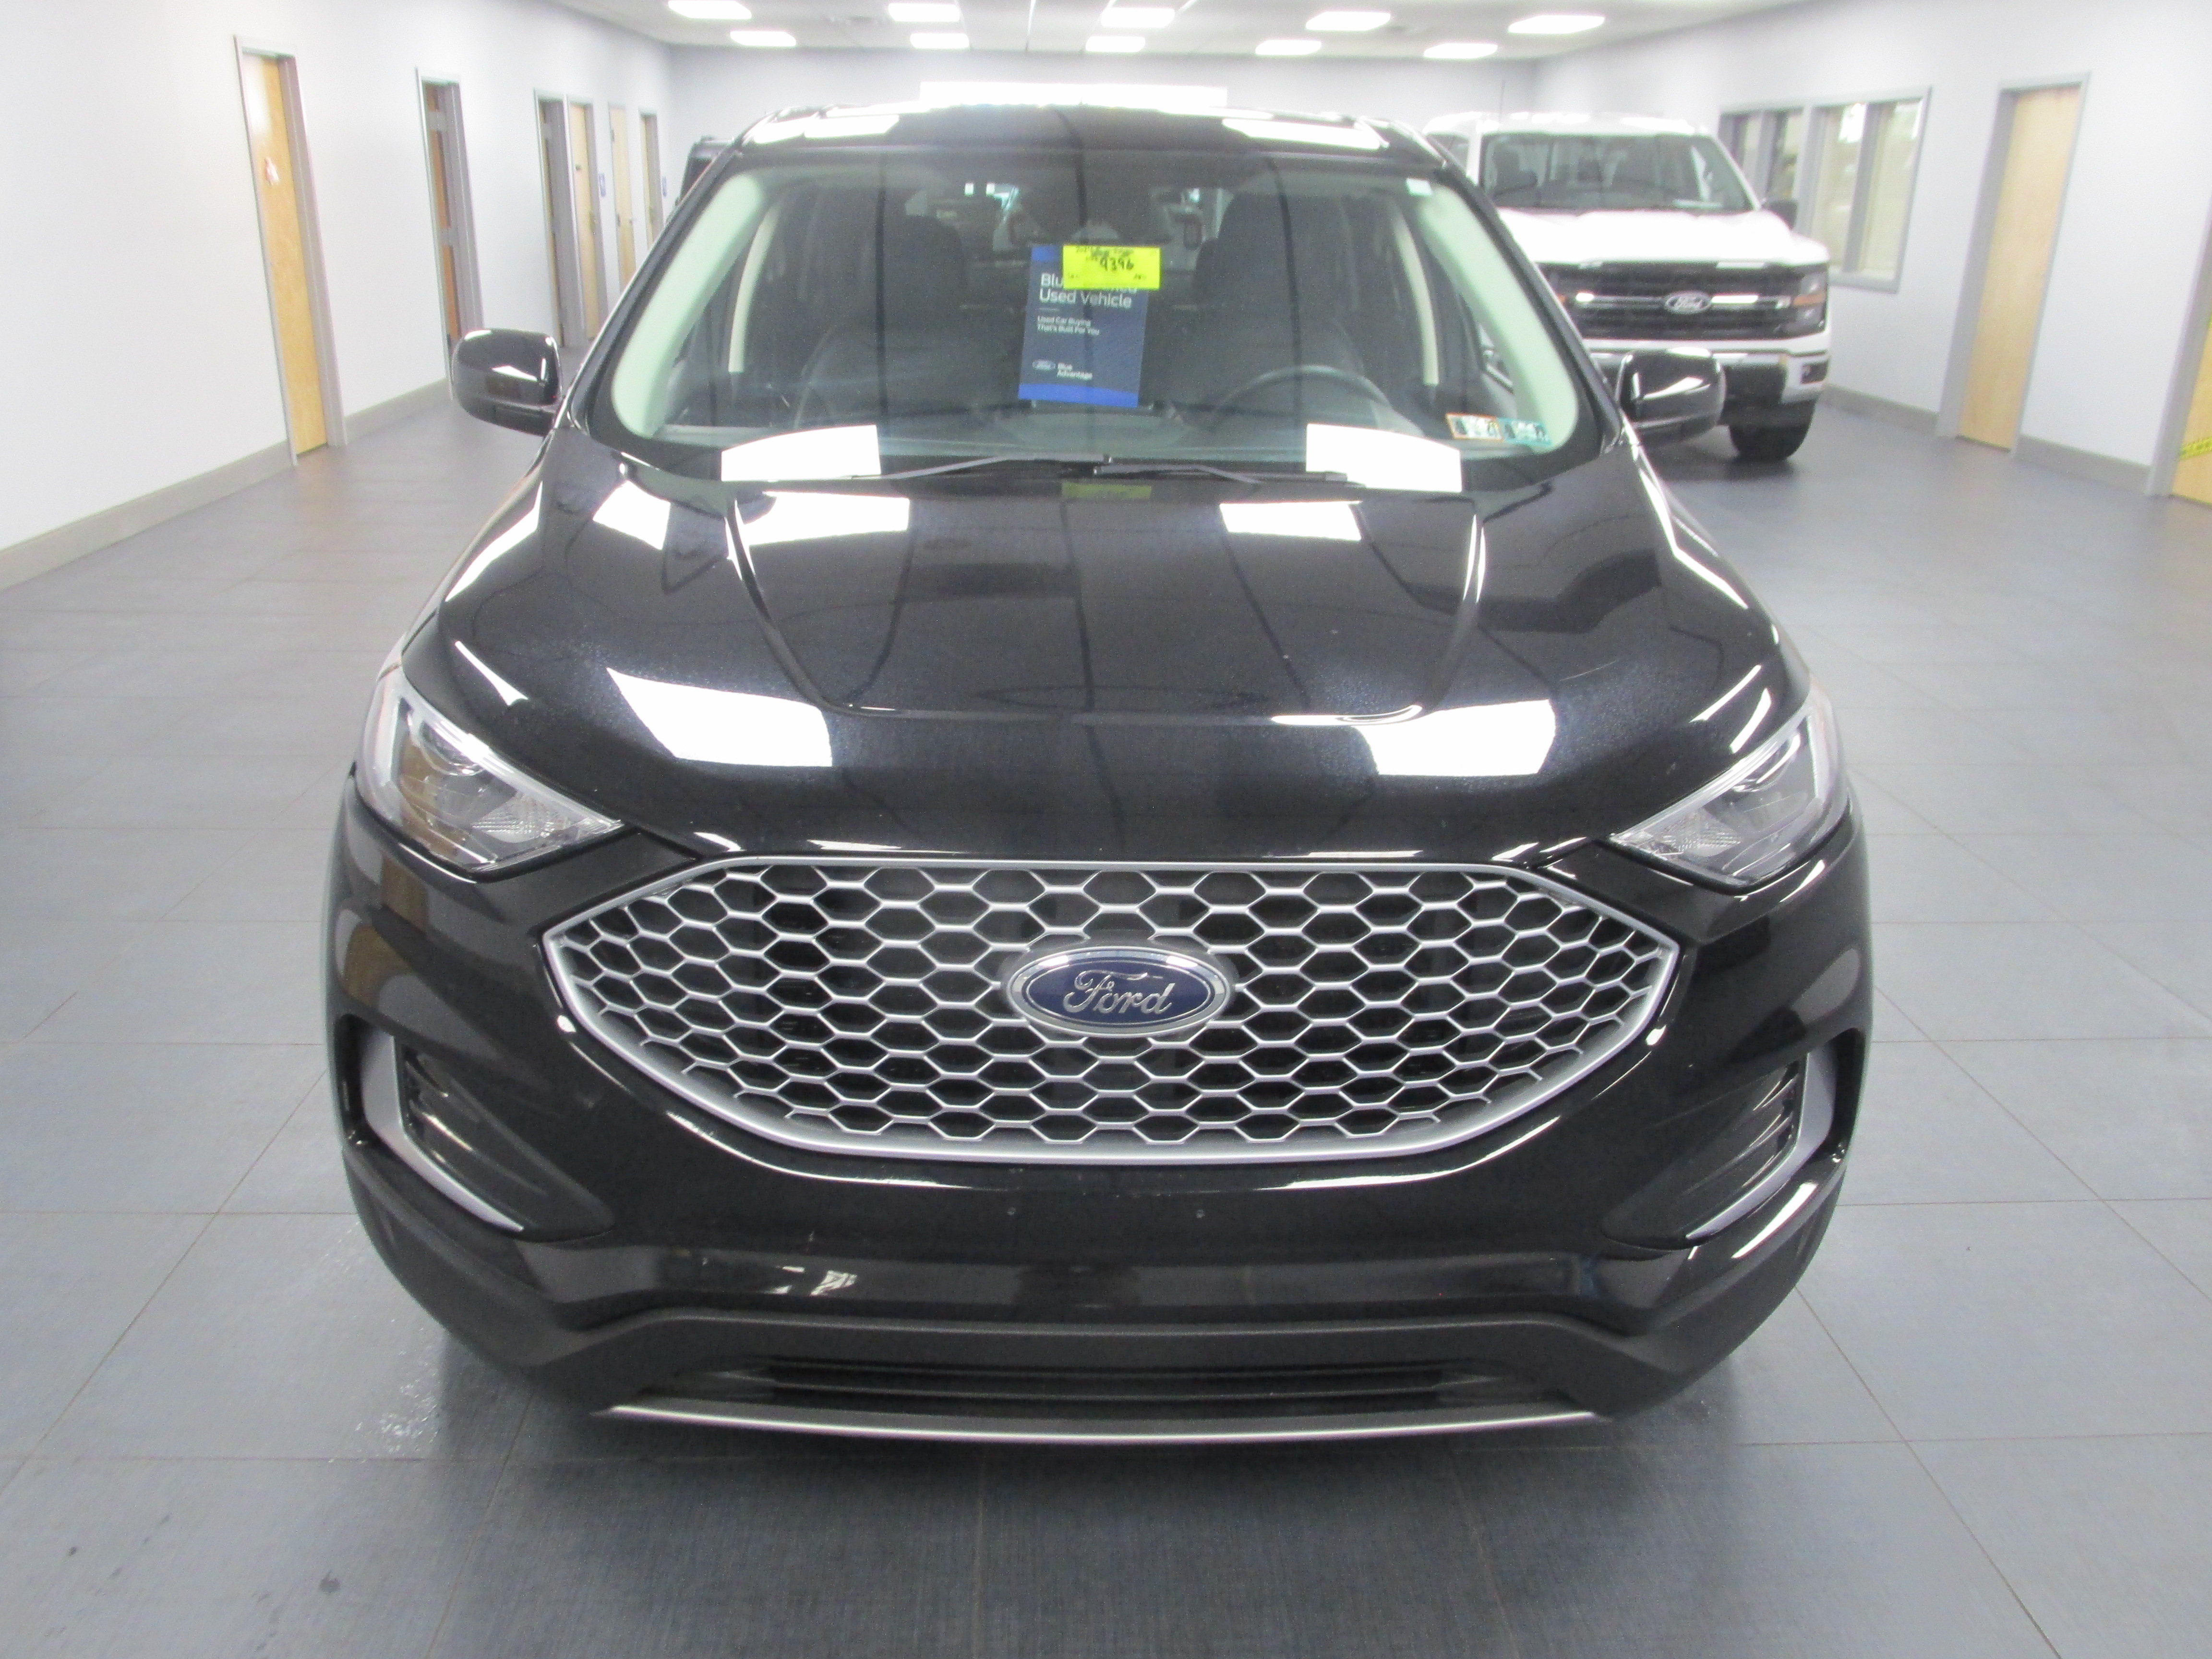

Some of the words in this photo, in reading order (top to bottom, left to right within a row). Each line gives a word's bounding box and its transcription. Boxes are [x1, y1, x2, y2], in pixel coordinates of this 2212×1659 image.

[1040, 273, 1063, 288] Blu
[1039, 288, 1076, 303] Used
[1081, 289, 1132, 308] Vehicle
[1062, 969, 1176, 1015] Ford
